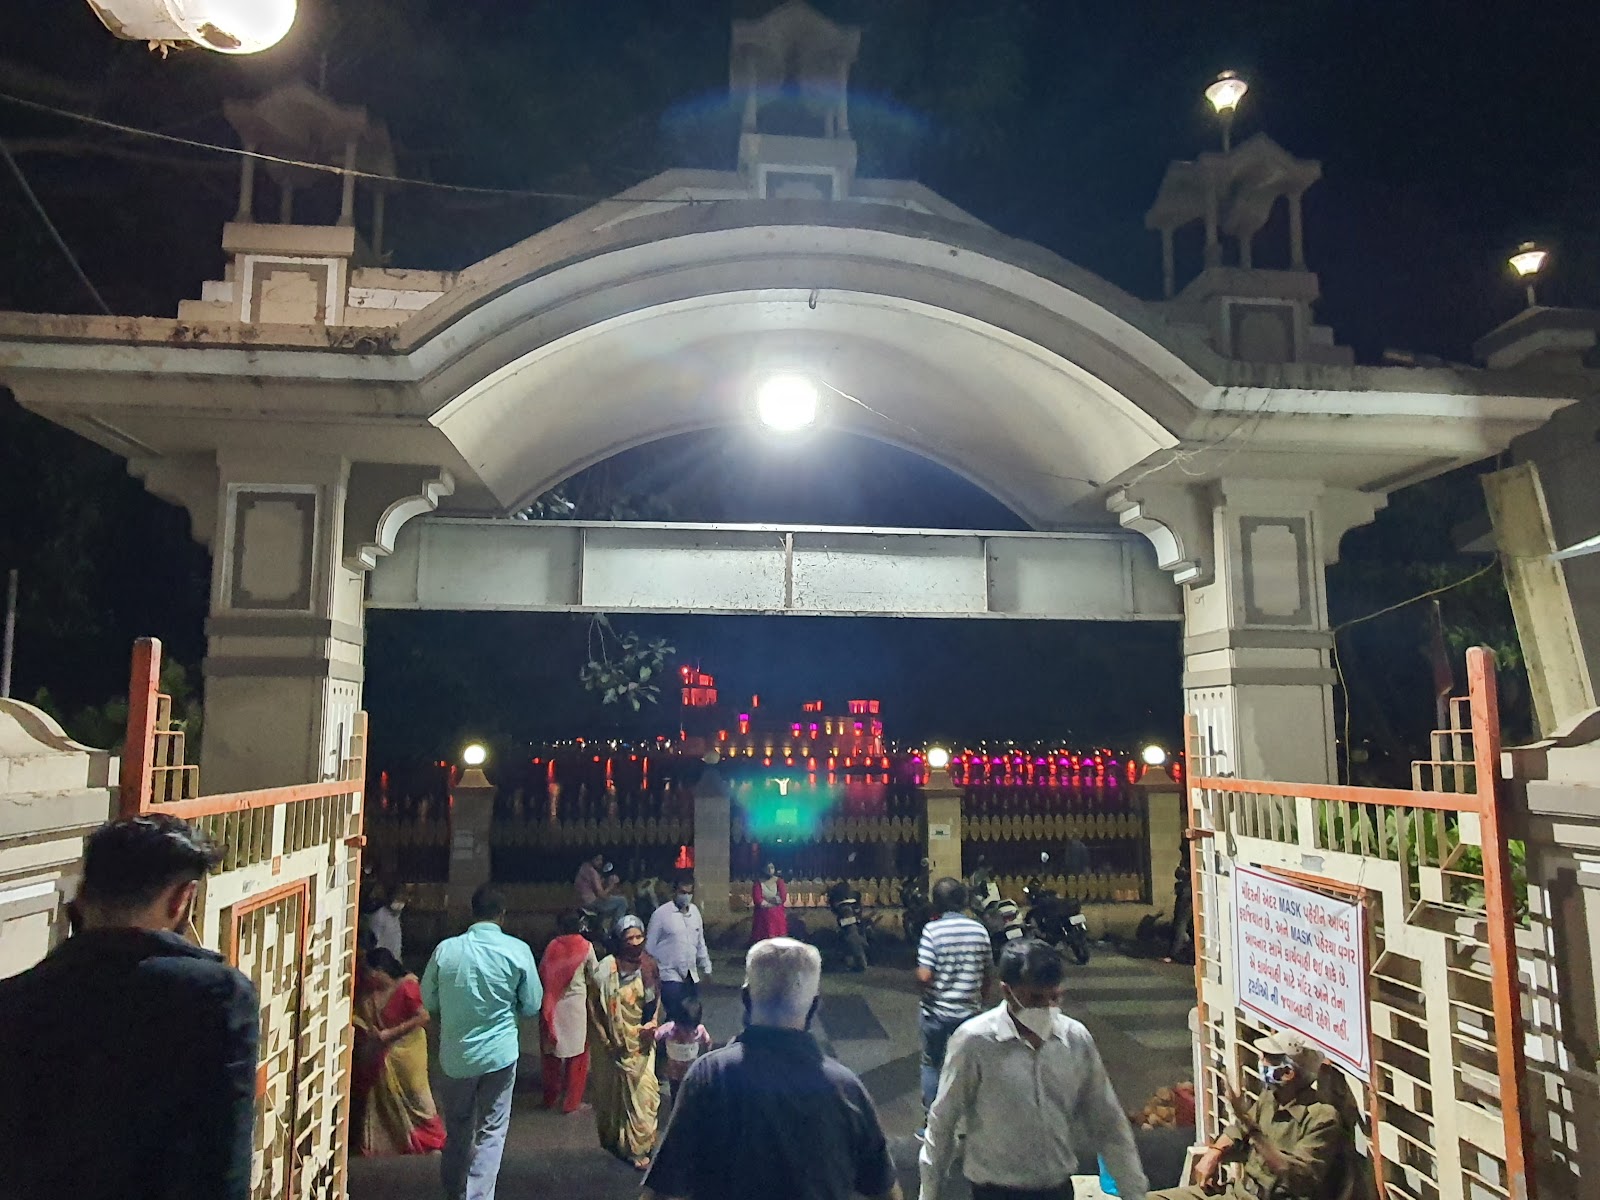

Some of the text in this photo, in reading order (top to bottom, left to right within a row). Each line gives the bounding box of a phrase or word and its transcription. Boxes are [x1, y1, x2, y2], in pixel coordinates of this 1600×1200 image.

[1262, 889, 1277, 910] અંદર
[1279, 896, 1302, 918] MASK
[1303, 902, 1326, 927] પહેરીને
[1328, 914, 1350, 942] આવવું
[1245, 931, 1267, 953] આવનાર
[1269, 939, 1282, 959] સામે
[1285, 946, 1310, 972] કાર્યવાહી
[1325, 961, 1337, 983] શકે
[1339, 965, 1349, 989] છે.
[1276, 918, 1288, 937] અને
[1291, 926, 1313, 947] MASK
[1338, 945, 1356, 965] વગર
[1271, 986, 1279, 1005] ની
[1316, 1006, 1330, 1032] રહેશે
[1283, 968, 1295, 989] માટે
[1297, 973, 1312, 998] મંદિર
[1314, 983, 1328, 1005] અને
[1331, 986, 1345, 1013] તેના
